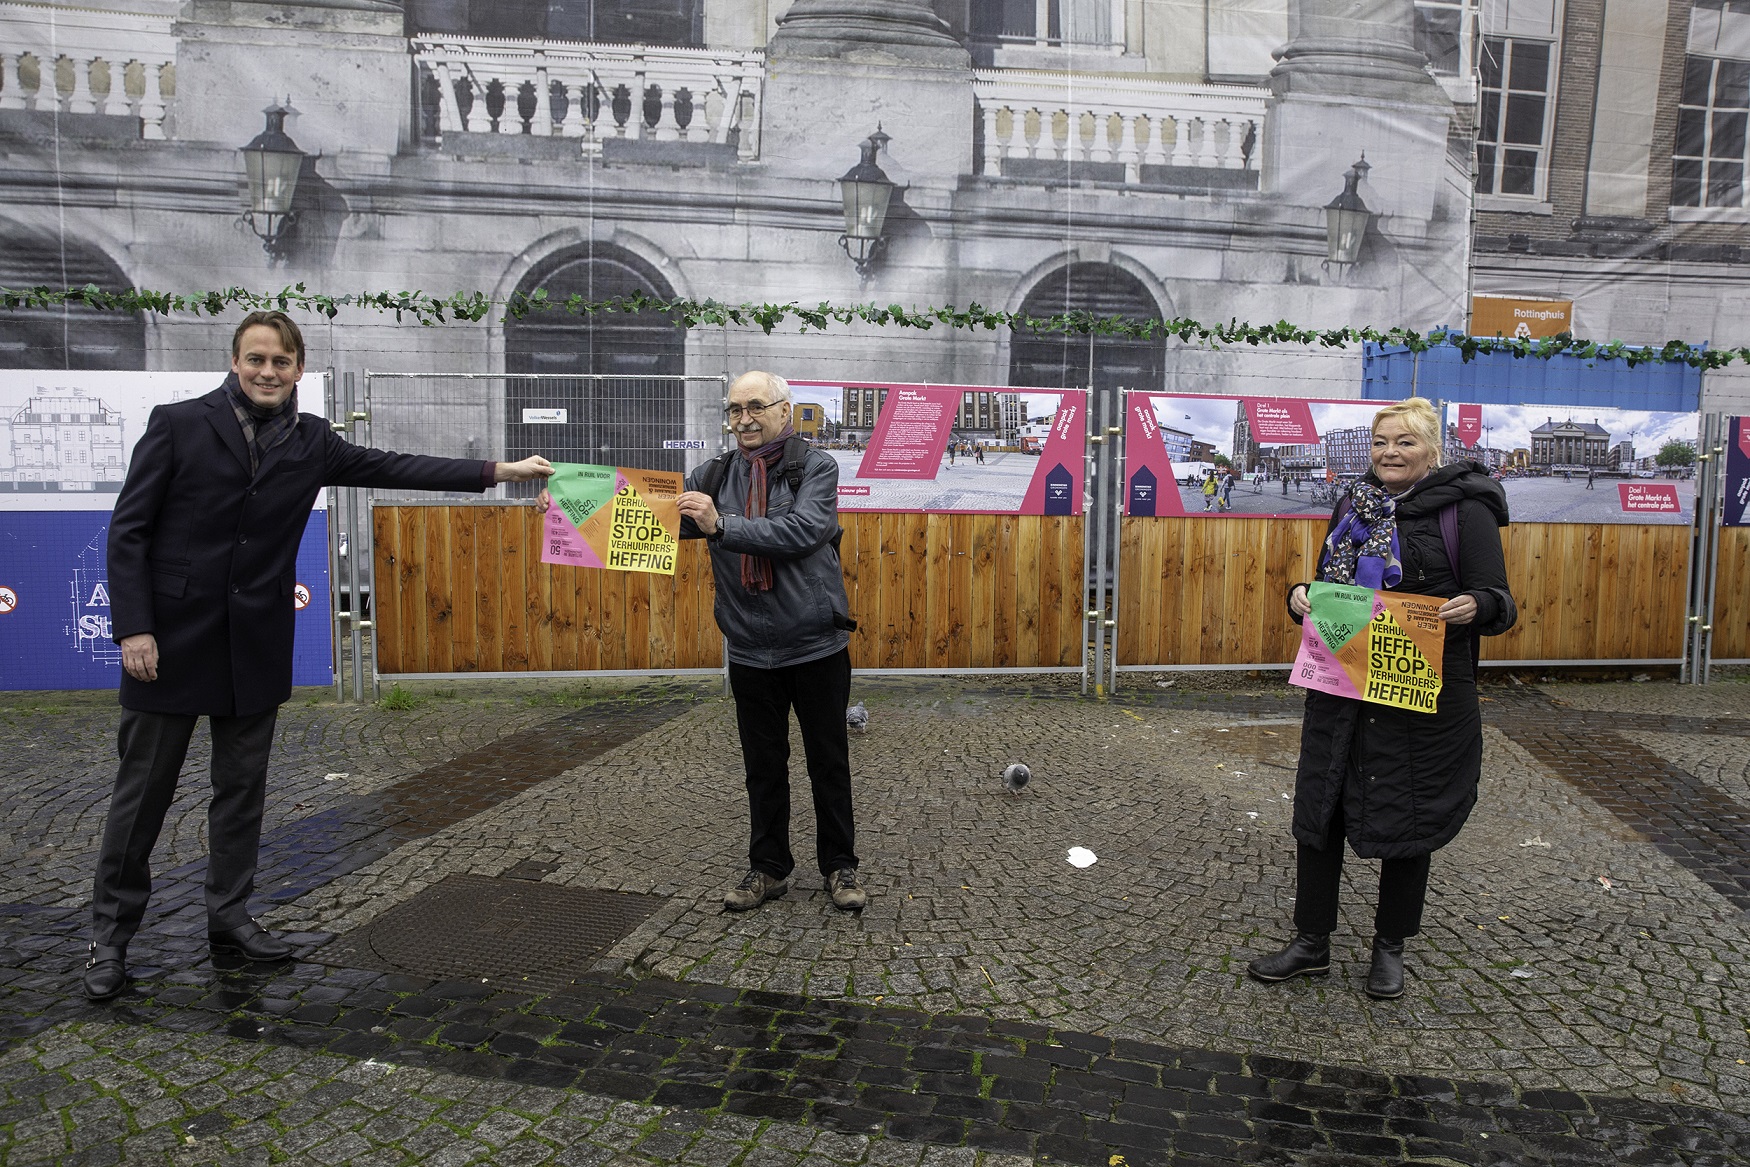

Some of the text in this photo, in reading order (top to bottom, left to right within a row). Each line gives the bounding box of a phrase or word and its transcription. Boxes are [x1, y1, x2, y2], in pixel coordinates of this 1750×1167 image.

[1514, 308, 1565, 320] Rottinghuis
[1056, 408, 1069, 432] aanpak
[1060, 405, 1077, 440] grote markt
[1134, 405, 1153, 440] grote markt
[1143, 408, 1157, 432] aanpak
[642, 476, 677, 485] WONINGEN
[558, 498, 581, 524] HEFFING
[1660, 502, 1675, 510] plein
[612, 524, 662, 542] STOP
[550, 545, 561, 556] 50
[611, 540, 675, 552] VERHUURDERS-
[609, 551, 672, 571] HEFFING
[1352, 594, 1368, 602] VOOR
[1316, 620, 1336, 650] HEFFING
[1417, 622, 1438, 630] MEER
[1371, 652, 1425, 675] STOP
[1300, 668, 1315, 680] 50
[1370, 669, 1440, 690] VERHUURDERS-
[1367, 680, 1435, 710] HEFFING
